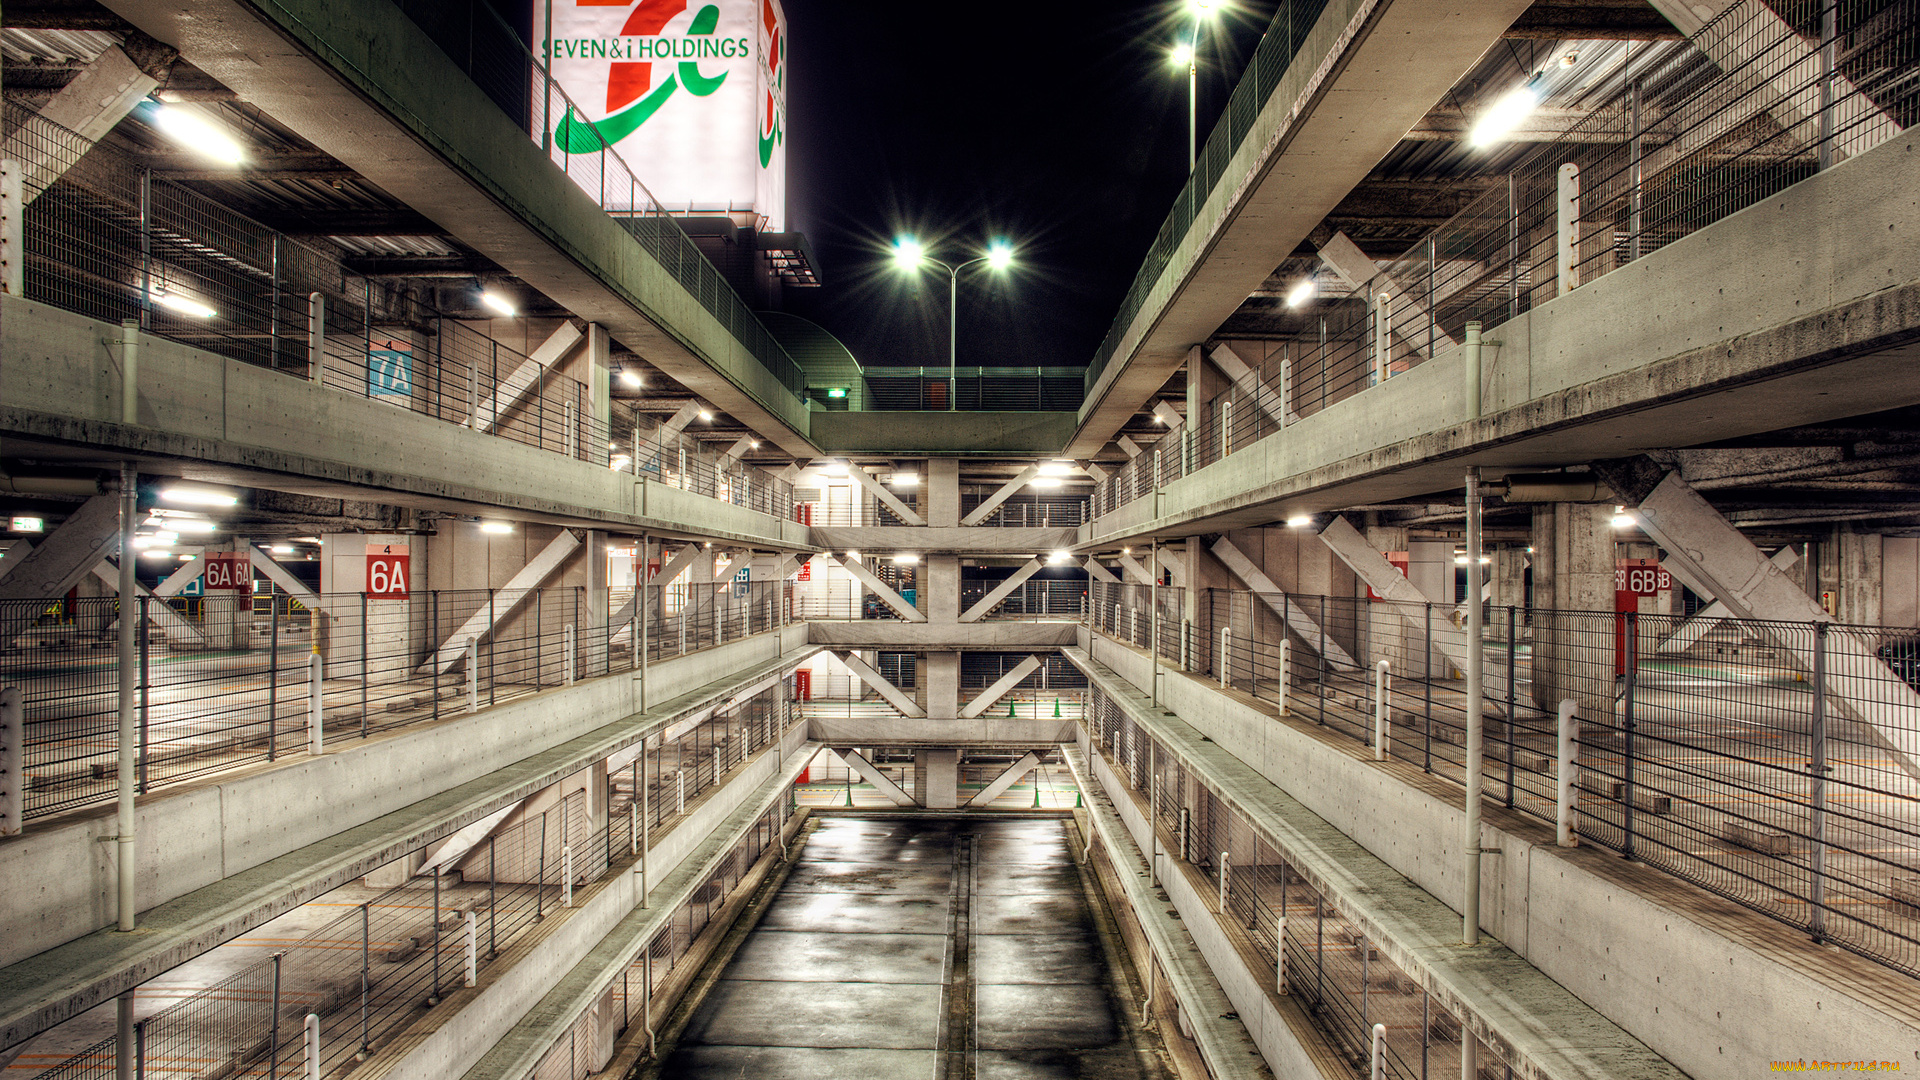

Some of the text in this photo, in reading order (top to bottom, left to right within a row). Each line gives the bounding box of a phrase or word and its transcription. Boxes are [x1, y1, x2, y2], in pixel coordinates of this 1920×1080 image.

[639, 38, 749, 58] HOLDINGS
[371, 355, 409, 390] 7A
[217, 551, 223, 559] 7
[383, 545, 392, 555] 4
[1640, 558, 1646, 566] 6
[207, 562, 232, 586] 6A
[235, 562, 249, 586] 6A
[370, 560, 407, 594] 6A
[1630, 569, 1656, 593] 6B
